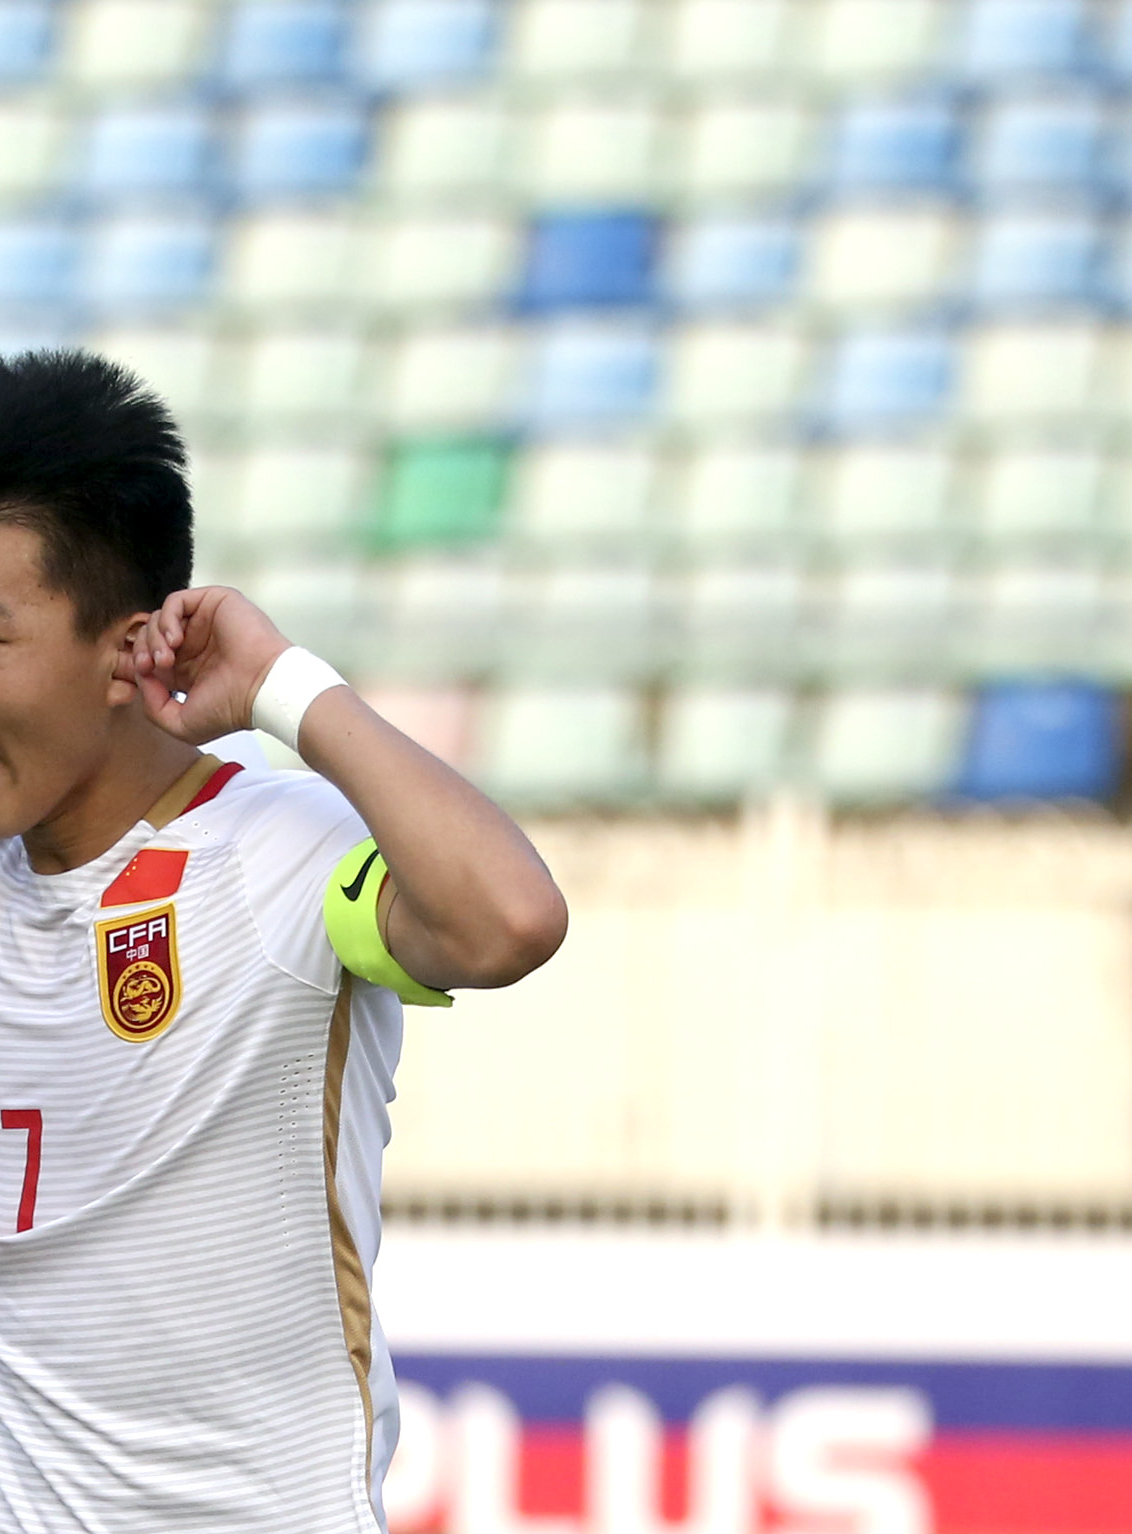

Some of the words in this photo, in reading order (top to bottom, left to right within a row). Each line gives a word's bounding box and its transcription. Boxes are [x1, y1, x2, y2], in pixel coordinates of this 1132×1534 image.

[109, 917, 167, 953] CFA
[126, 944, 149, 961] 中国
[0, 1109, 42, 1233] 7
